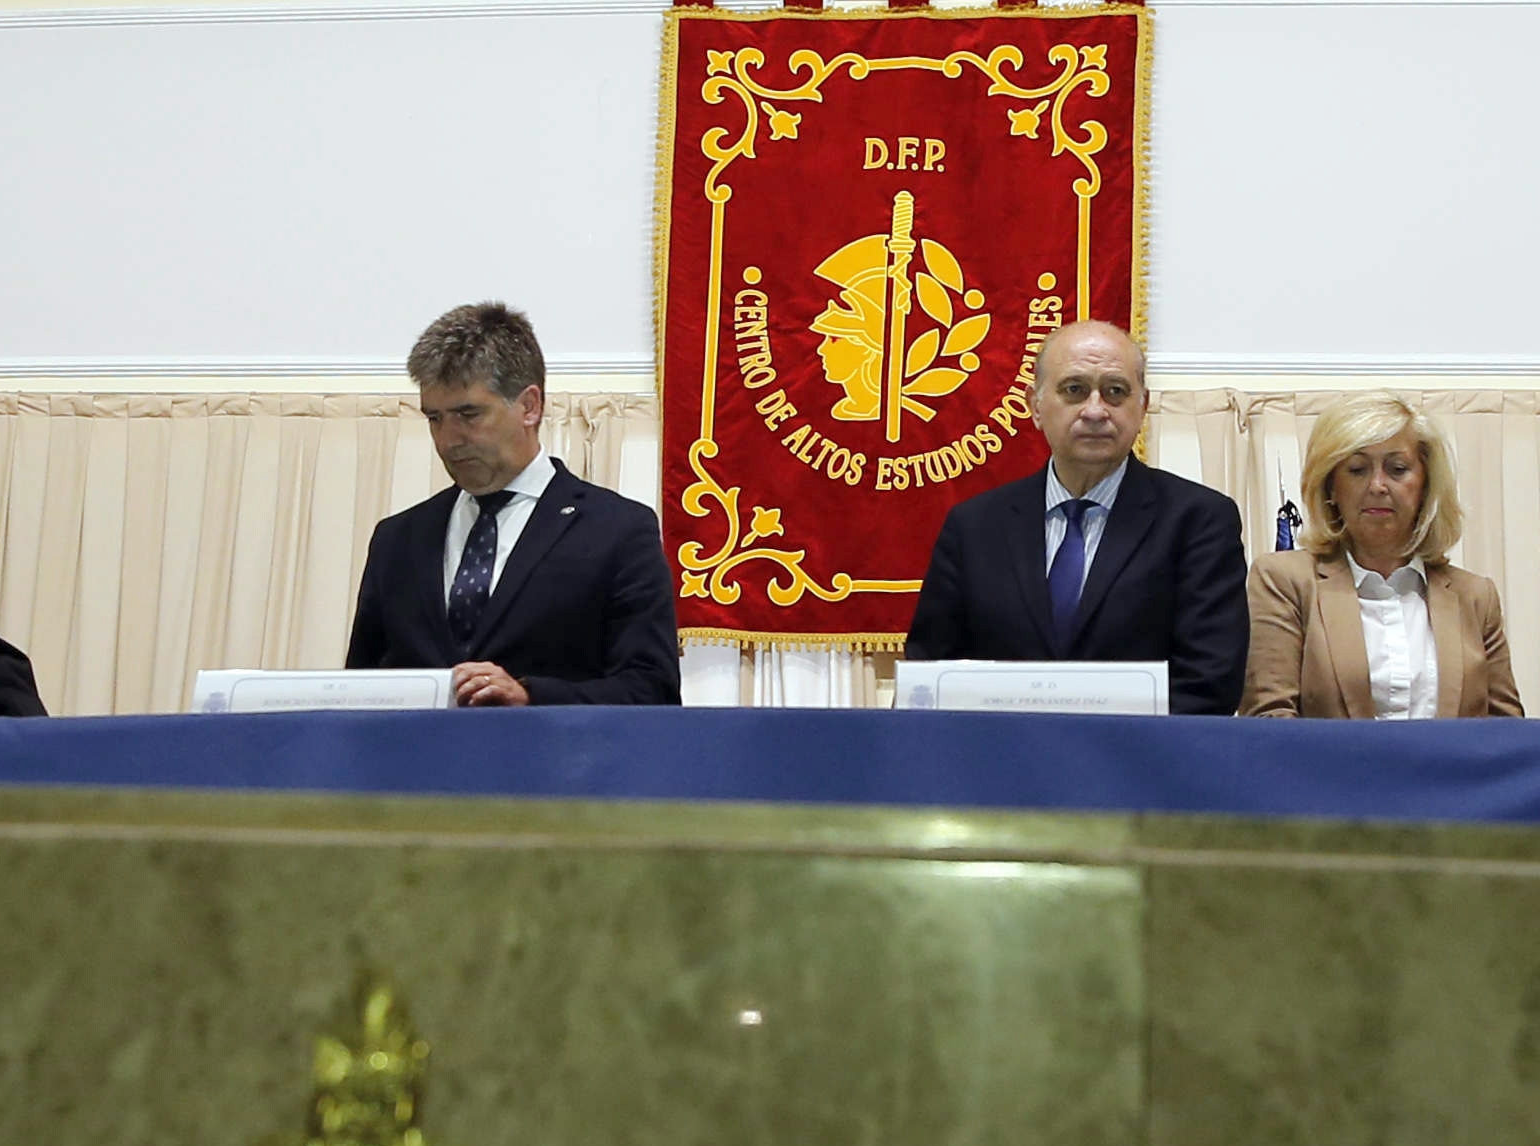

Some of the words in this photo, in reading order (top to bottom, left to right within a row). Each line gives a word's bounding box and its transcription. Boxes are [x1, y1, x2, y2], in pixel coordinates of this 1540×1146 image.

[862, 136, 946, 173] D.F.P.
[734, 288, 777, 390] CENTRO
[755, 388, 798, 432] DE
[781, 424, 867, 486] ALTOS
[875, 424, 1003, 491] ESTUDIOS
